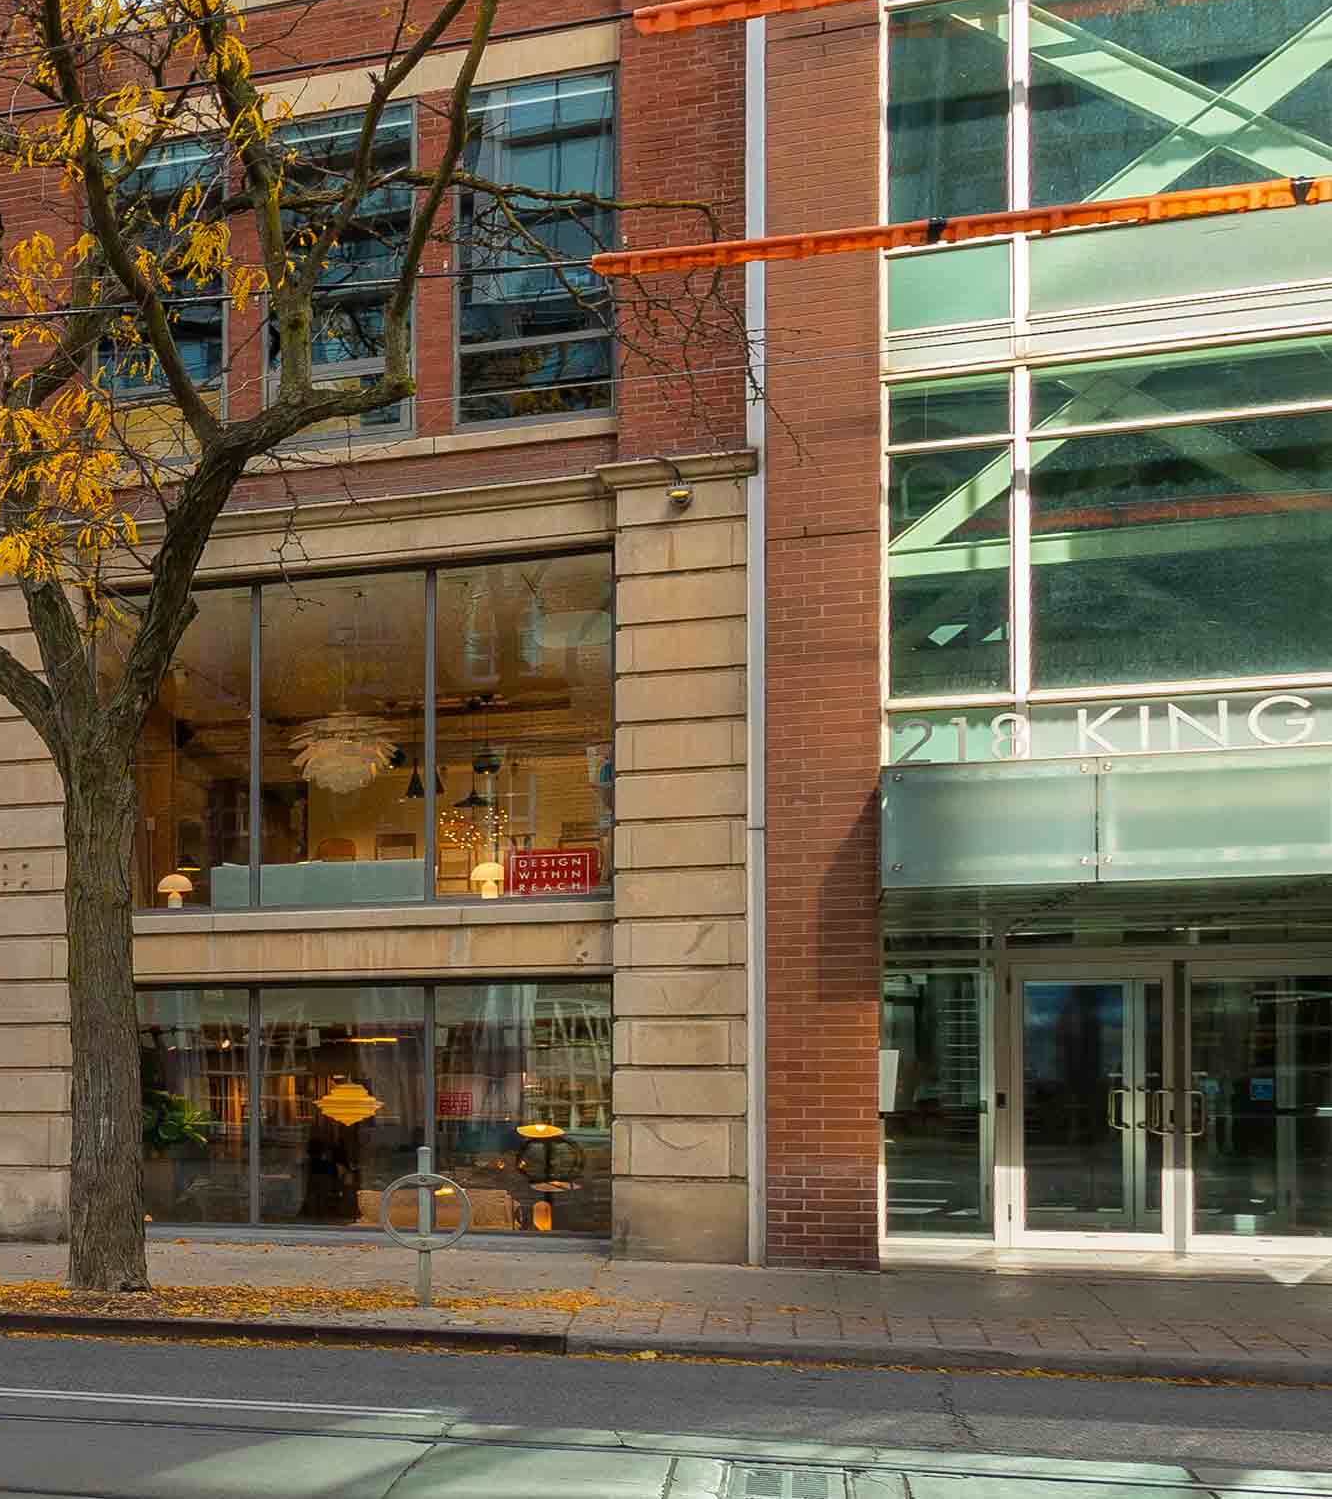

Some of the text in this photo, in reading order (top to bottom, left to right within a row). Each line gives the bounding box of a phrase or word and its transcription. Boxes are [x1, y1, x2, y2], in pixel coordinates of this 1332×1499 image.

[894, 694, 1316, 765] 218 KING
[518, 857, 582, 869] DESIGN
[518, 870, 582, 880] WITHIN
[518, 882, 582, 893] REACH
